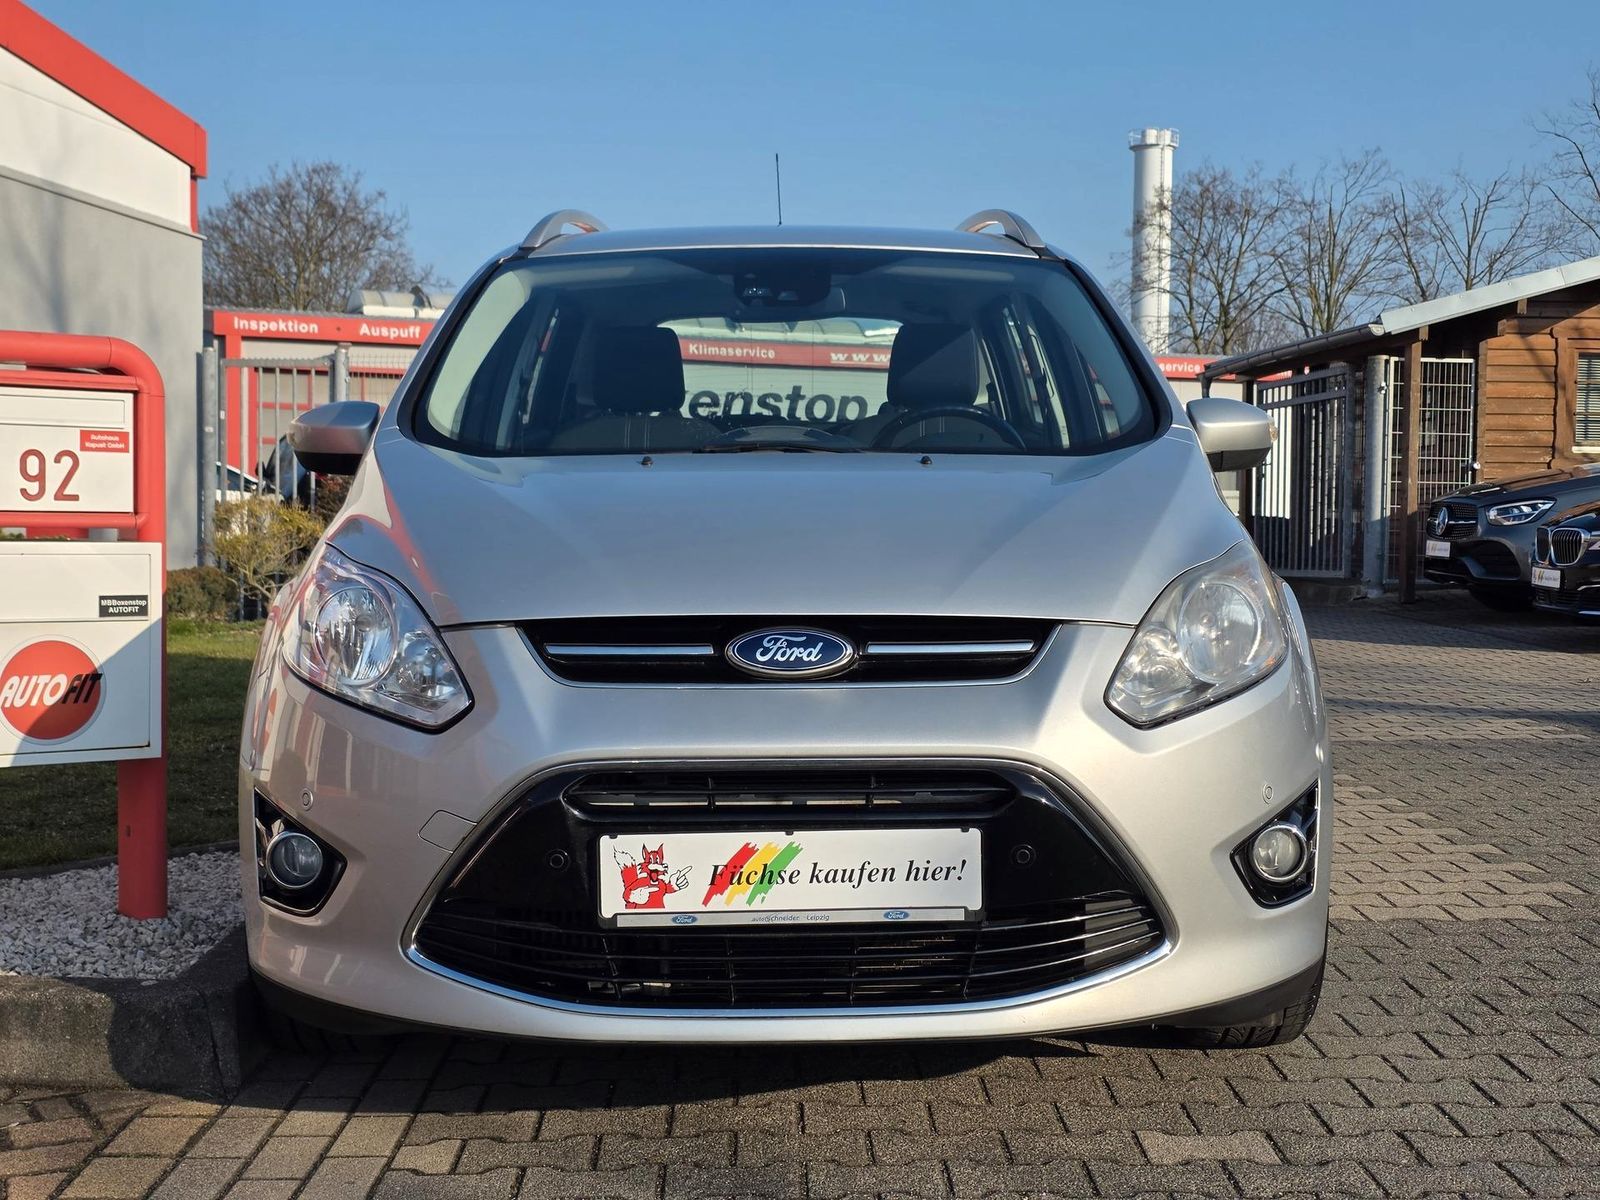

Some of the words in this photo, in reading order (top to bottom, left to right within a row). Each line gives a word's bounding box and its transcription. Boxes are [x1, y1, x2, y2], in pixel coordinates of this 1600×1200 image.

[233, 315, 319, 334] Inspektion
[359, 323, 421, 339] Auspuff
[689, 343, 776, 360] Klimaservice
[684, 385, 869, 423] enstop
[19, 448, 80, 502] 92
[108, 606, 140, 614] AUTOFIT
[755, 634, 824, 662] Ford
[0, 673, 103, 708] AUTOFIT
[708, 863, 801, 887] Füchse
[808, 861, 897, 889] kaufen
[904, 858, 967, 883] hier!
